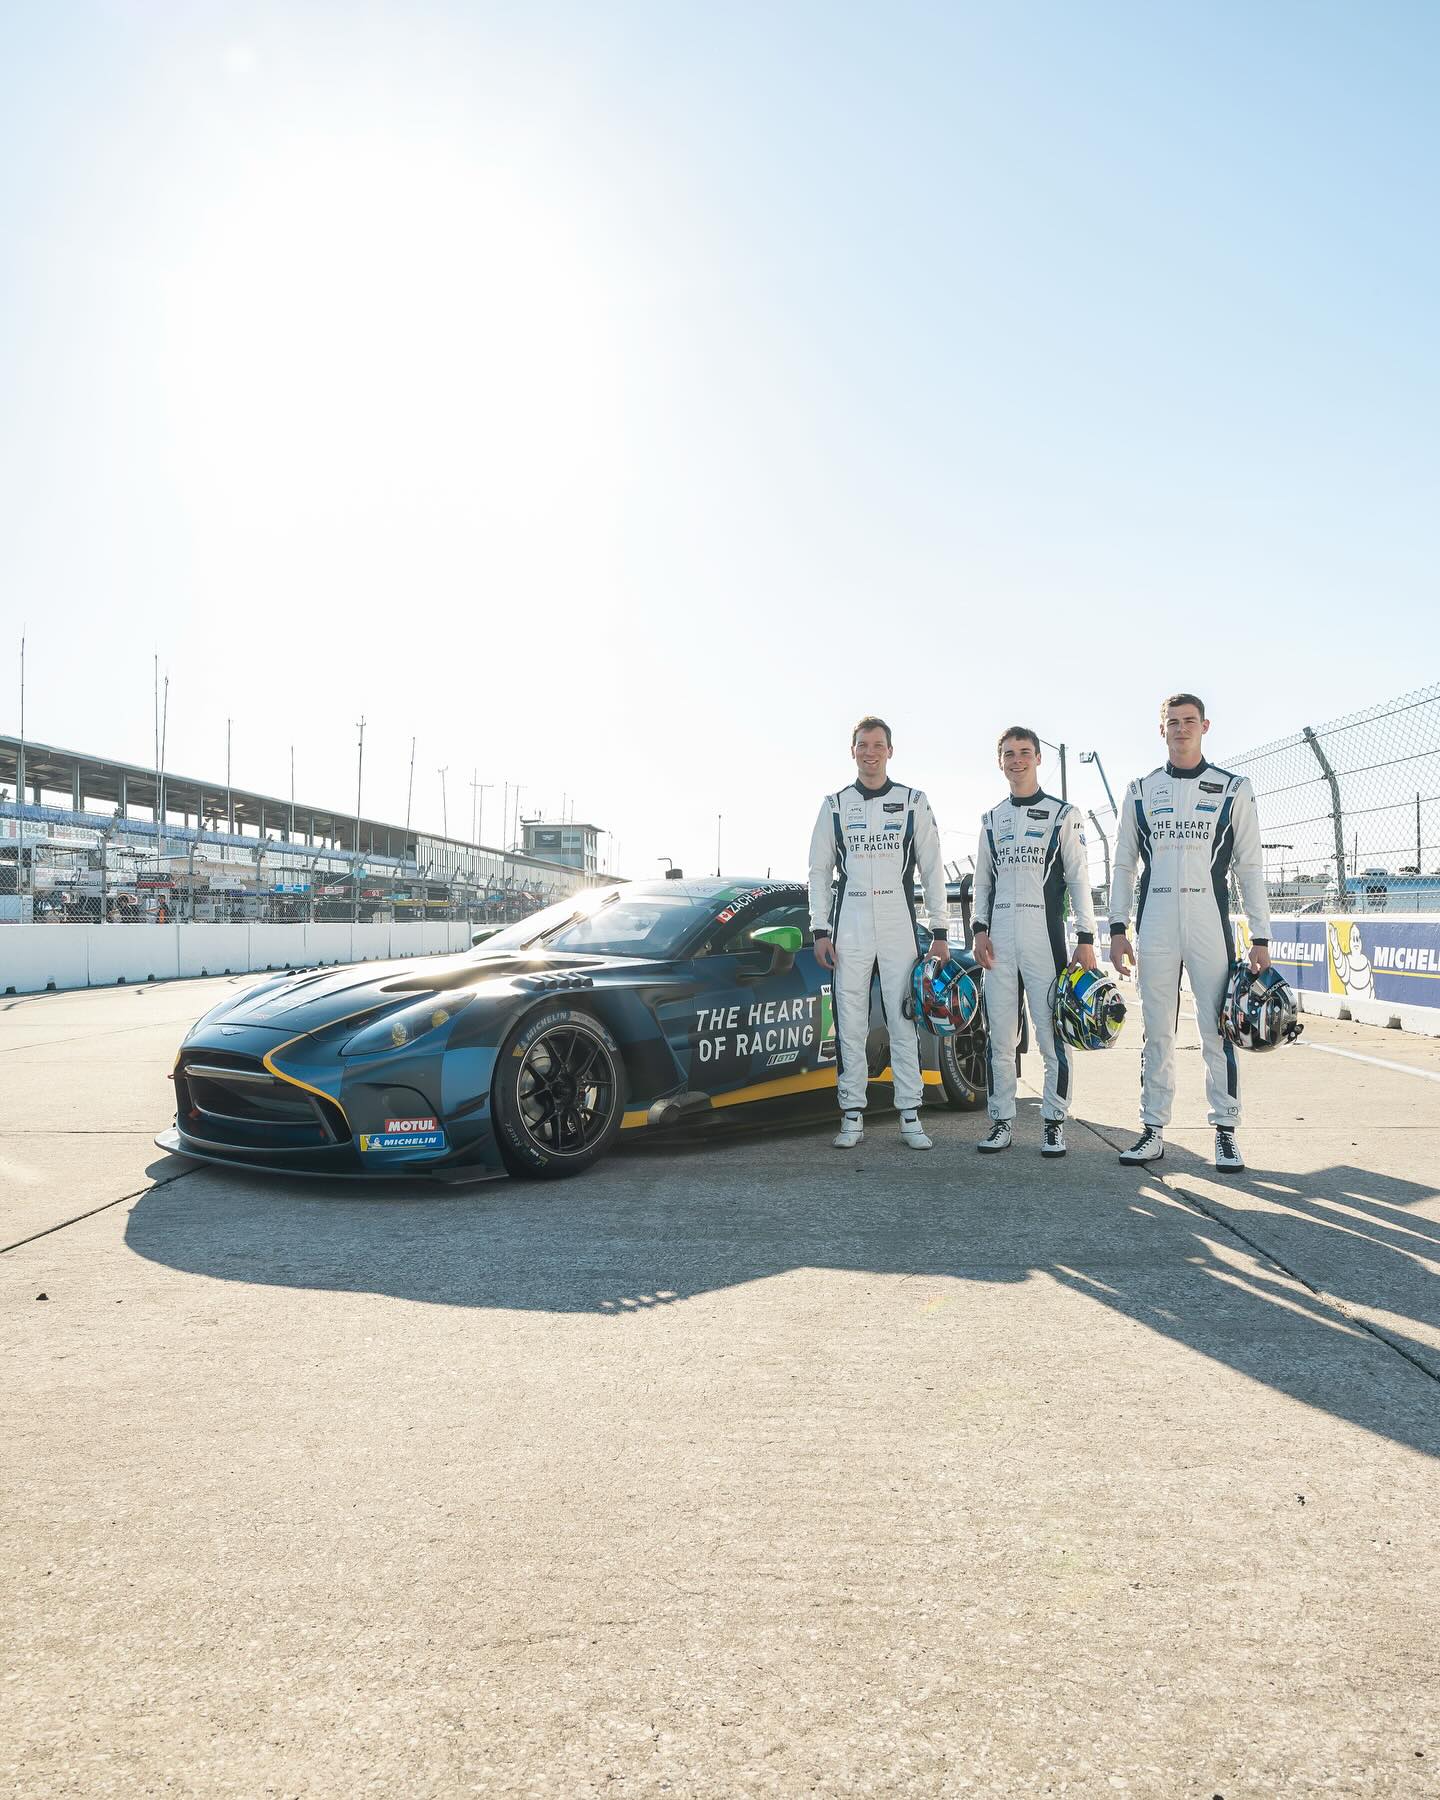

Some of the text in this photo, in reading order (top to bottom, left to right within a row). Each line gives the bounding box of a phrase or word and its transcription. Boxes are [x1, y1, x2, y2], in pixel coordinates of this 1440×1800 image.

[1152, 820, 1212, 830] HE HEART
[847, 833, 900, 843] THE HEART
[1152, 830, 1209, 840] OF RACING
[849, 842, 900, 852] OF RACING
[998, 845, 1046, 856] HE HEART
[1008, 855, 1045, 865] RACING
[762, 883, 802, 895] CASPER
[727, 894, 755, 914] ZACH
[1268, 941, 1326, 962] MICHELIN
[1373, 946, 1440, 971] MICHEL
[696, 997, 817, 1031] THE HEART
[698, 1036, 727, 1062] OF
[735, 1025, 814, 1057] RACING
[776, 1053, 796, 1063] GTD
[388, 1119, 435, 1132] MOTUL
[383, 1136, 437, 1146] MICHELIN
